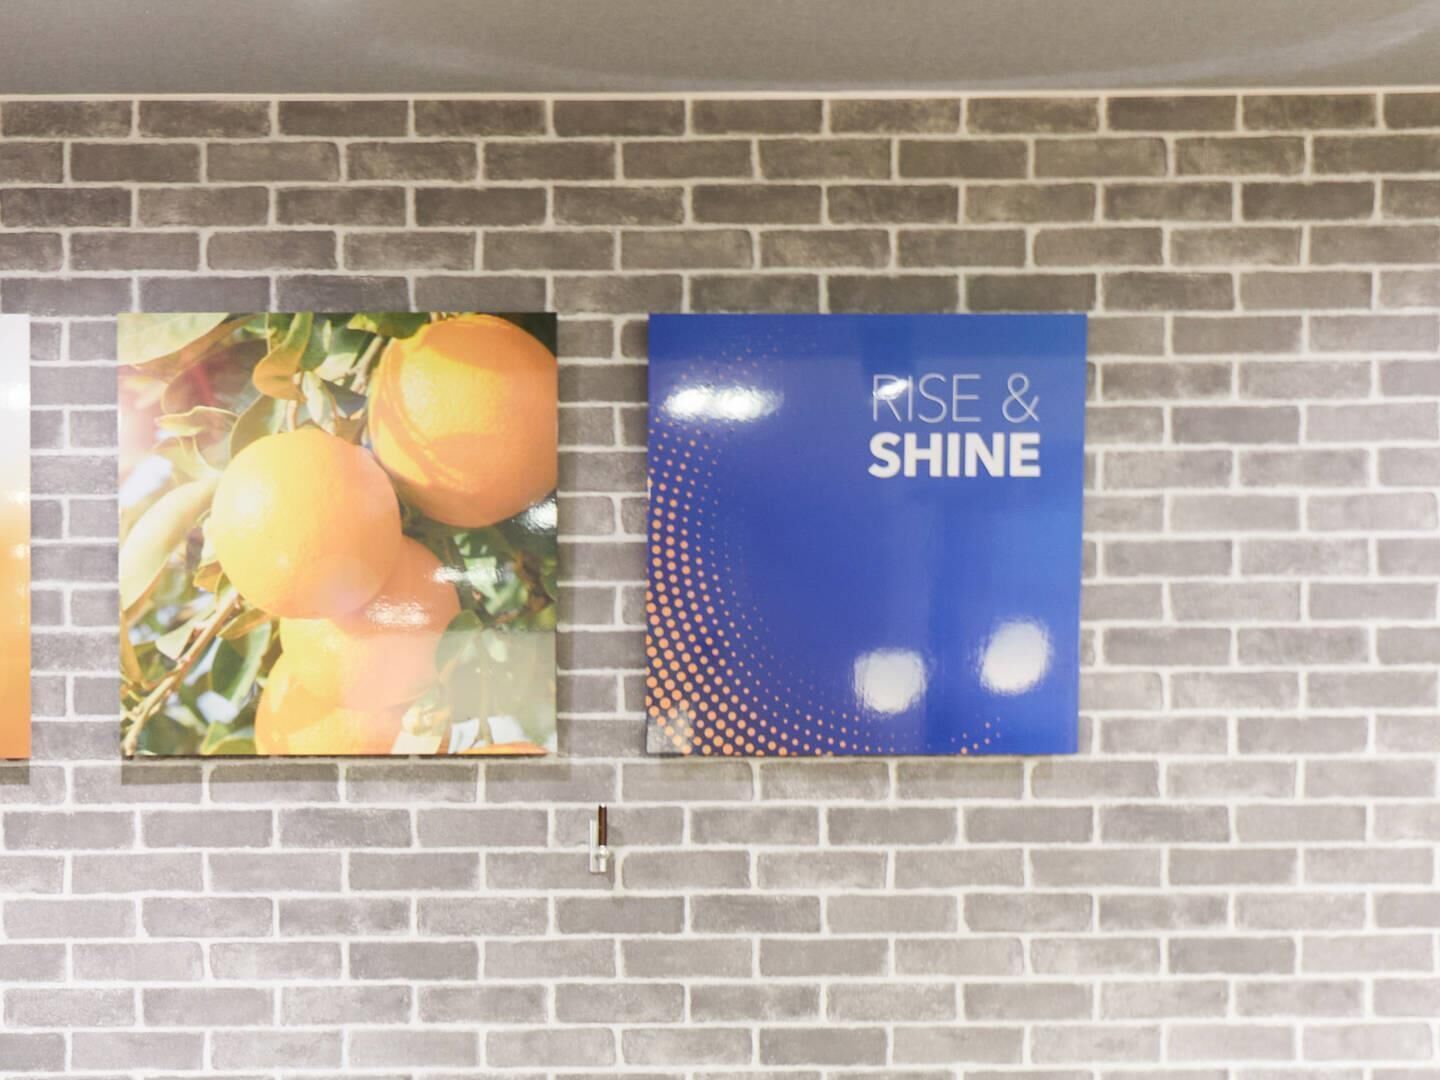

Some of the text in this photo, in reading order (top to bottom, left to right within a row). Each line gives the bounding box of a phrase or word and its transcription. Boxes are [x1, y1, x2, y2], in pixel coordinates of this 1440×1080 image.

[872, 372, 1040, 424] RISE &
[868, 431, 1041, 478] SHINE
